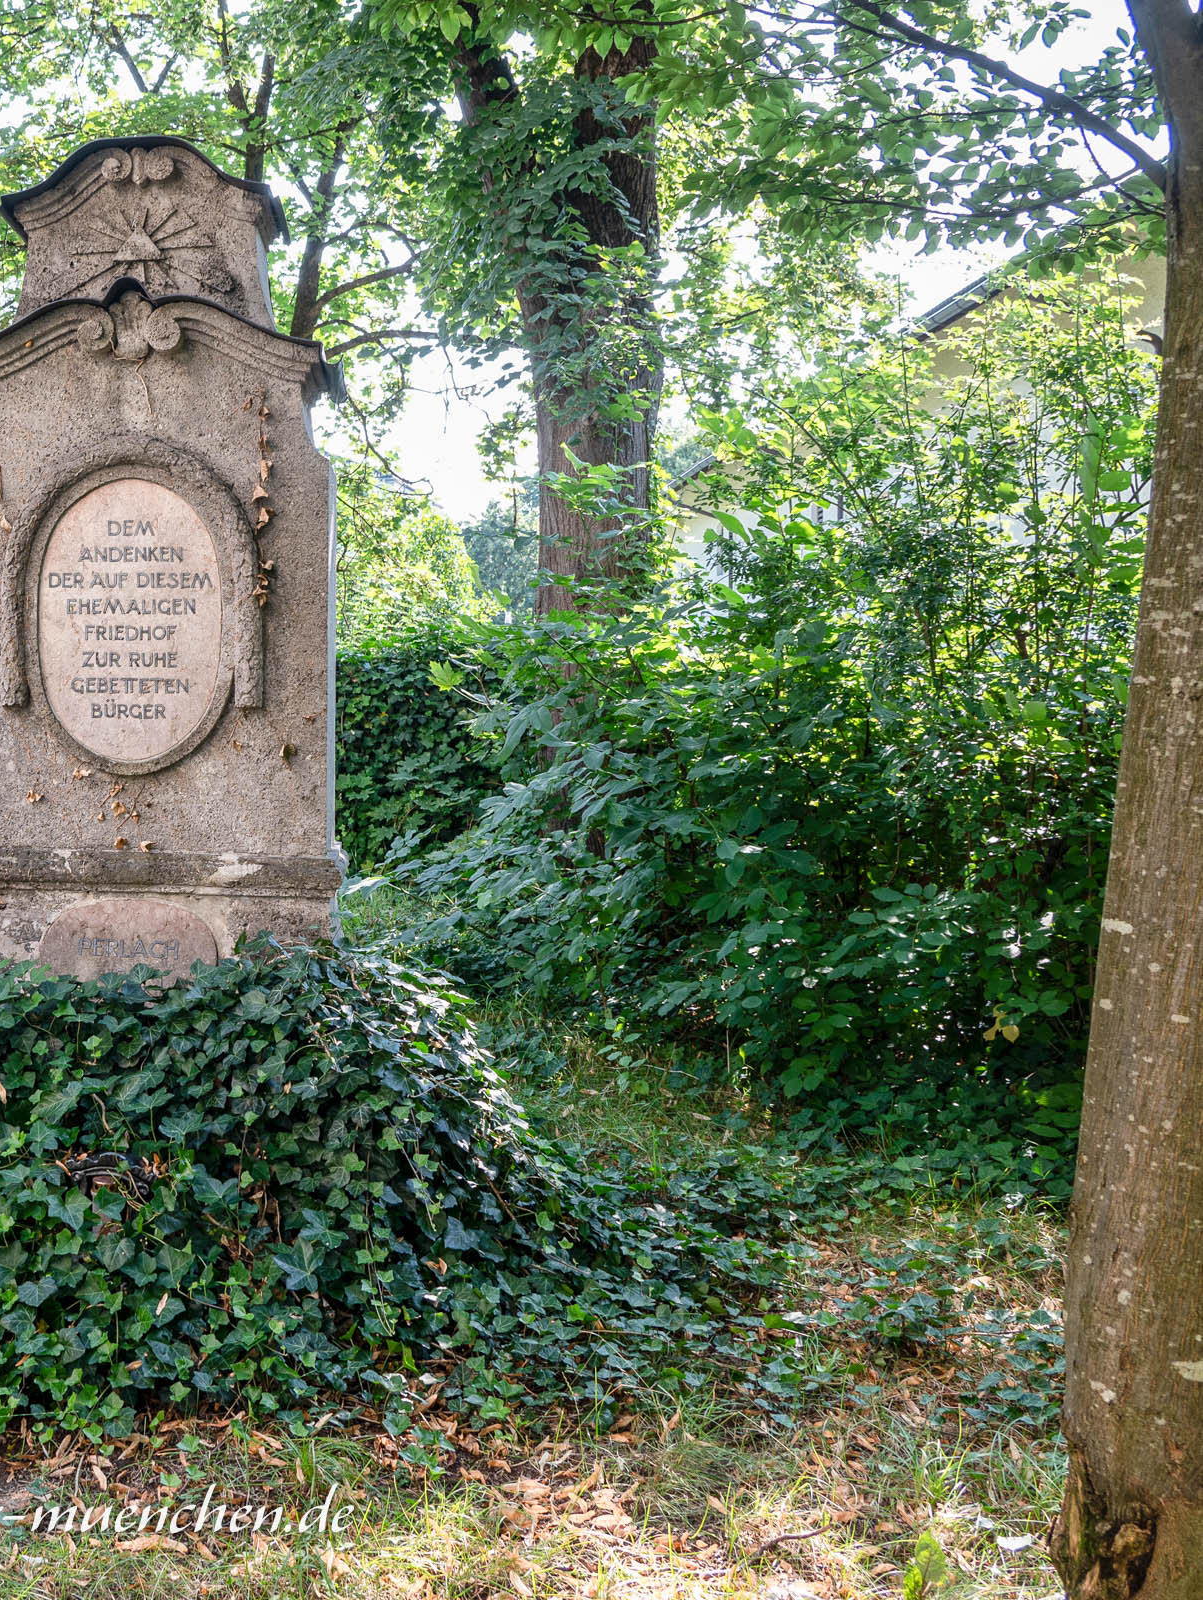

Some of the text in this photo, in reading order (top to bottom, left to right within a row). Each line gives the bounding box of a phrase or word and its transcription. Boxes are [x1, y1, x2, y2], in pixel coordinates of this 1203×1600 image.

[107, 520, 155, 536] DEM
[79, 546, 183, 563] ANDENKEN
[48, 572, 213, 589] DER AUF DIESEM
[66, 599, 196, 615] EHEMALIGEN
[84, 625, 177, 641] FRIEDHOF
[82, 652, 178, 668] ZUR RUHE
[71, 677, 189, 694] GEBETTETEN
[90, 699, 166, 719] BÜRGER
[78, 938, 178, 960] PERLACH
